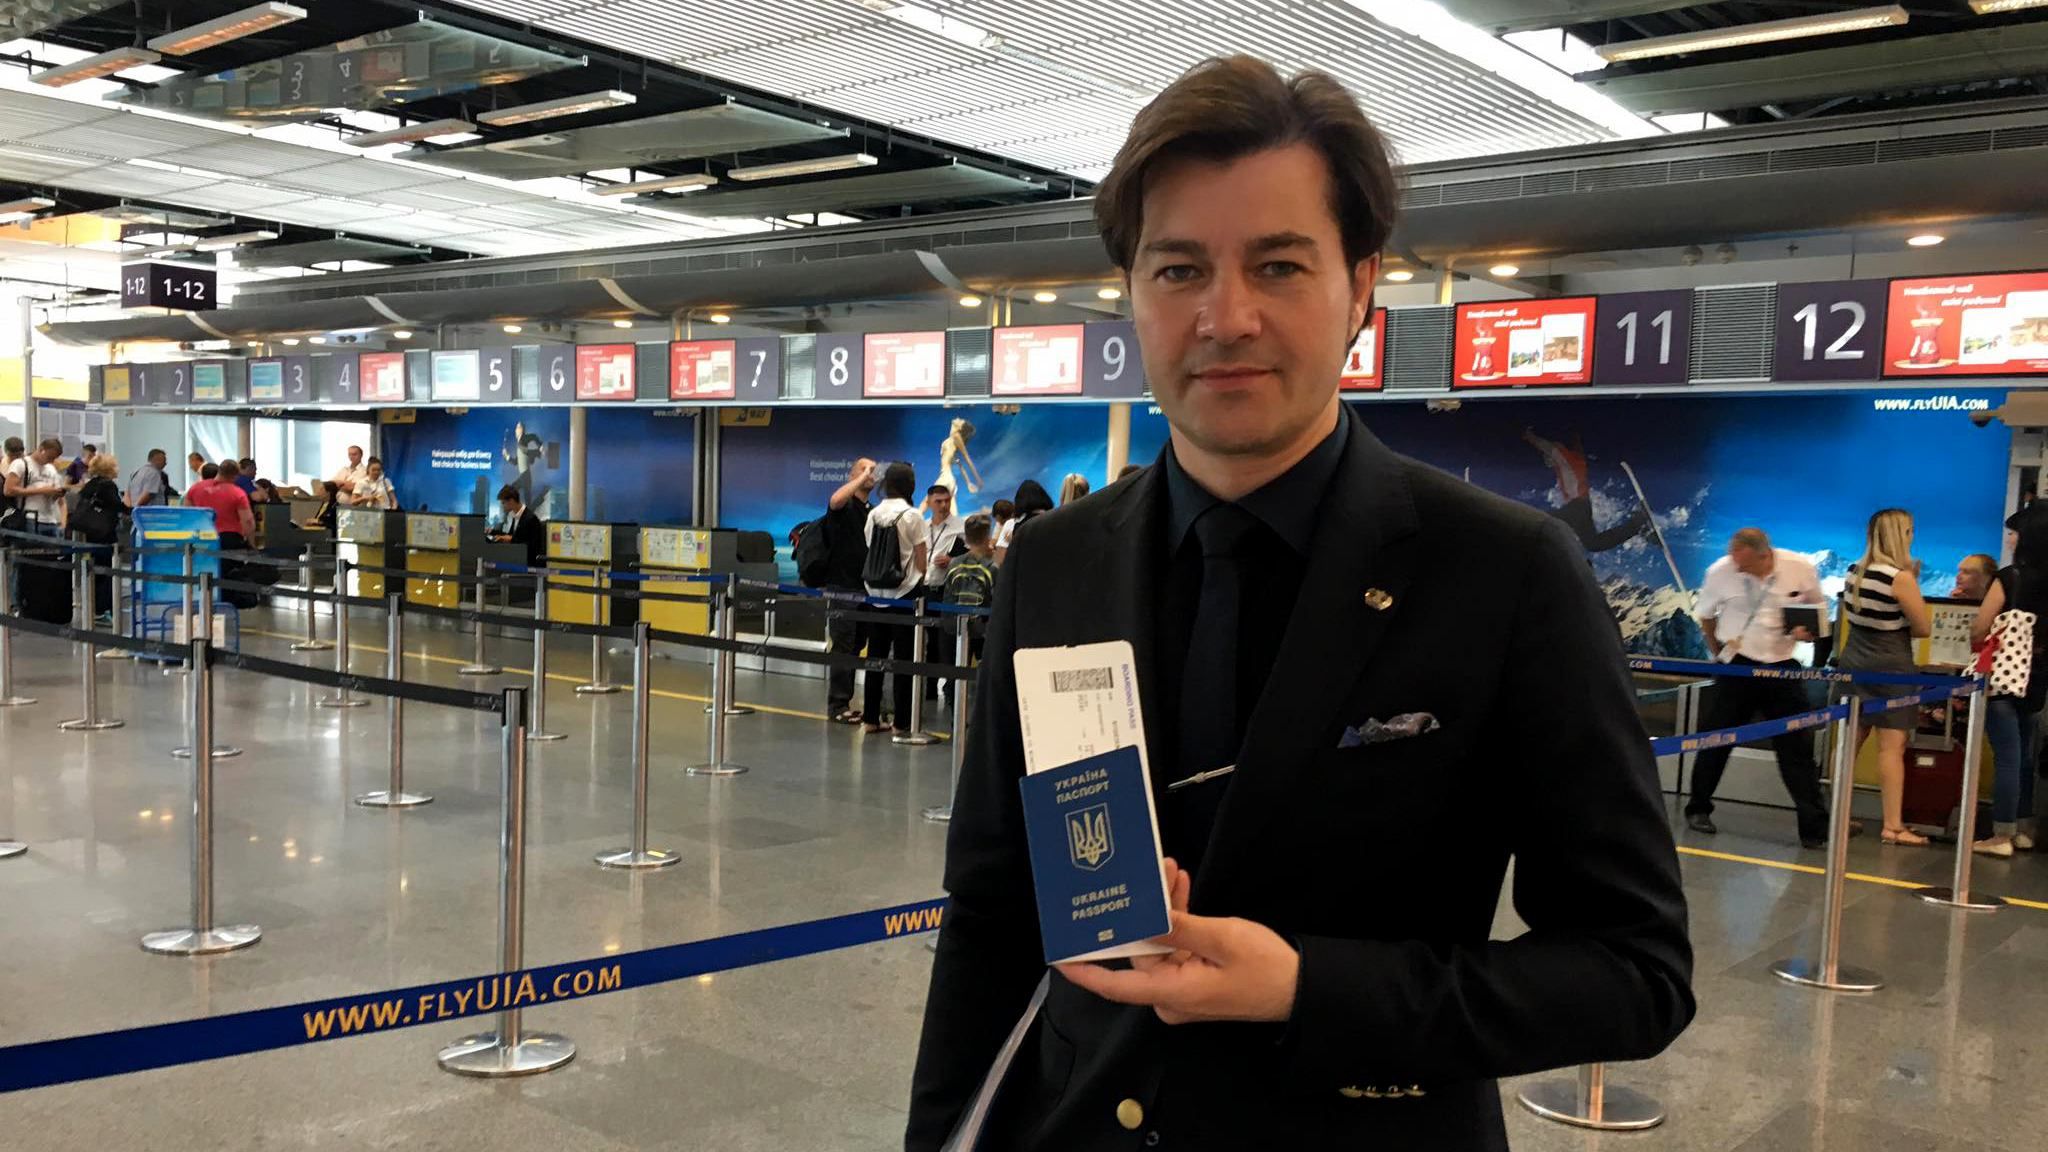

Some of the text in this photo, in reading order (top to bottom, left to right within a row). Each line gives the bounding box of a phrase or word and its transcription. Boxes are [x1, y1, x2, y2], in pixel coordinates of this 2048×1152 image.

[126, 277, 146, 296] 1-12
[163, 278, 205, 301] 1-12
[1616, 310, 1672, 366] 11
[1792, 300, 1867, 361] 12
[749, 350, 767, 388] 7
[828, 346, 849, 387] 8
[1102, 335, 1126, 381] 9
[139, 371, 146, 397] 1
[174, 368, 184, 396] 2
[292, 364, 304, 393] 3
[338, 363, 352, 393] 4
[488, 357, 504, 392] 5
[550, 356, 565, 391] 6
[1056, 780, 1110, 805] ПАСПОРТ
[1072, 883, 1128, 907] UKRAINE
[1072, 897, 1131, 921] PASSPORT
[302, 964, 623, 1039] WWW.FLYUIA.COM
